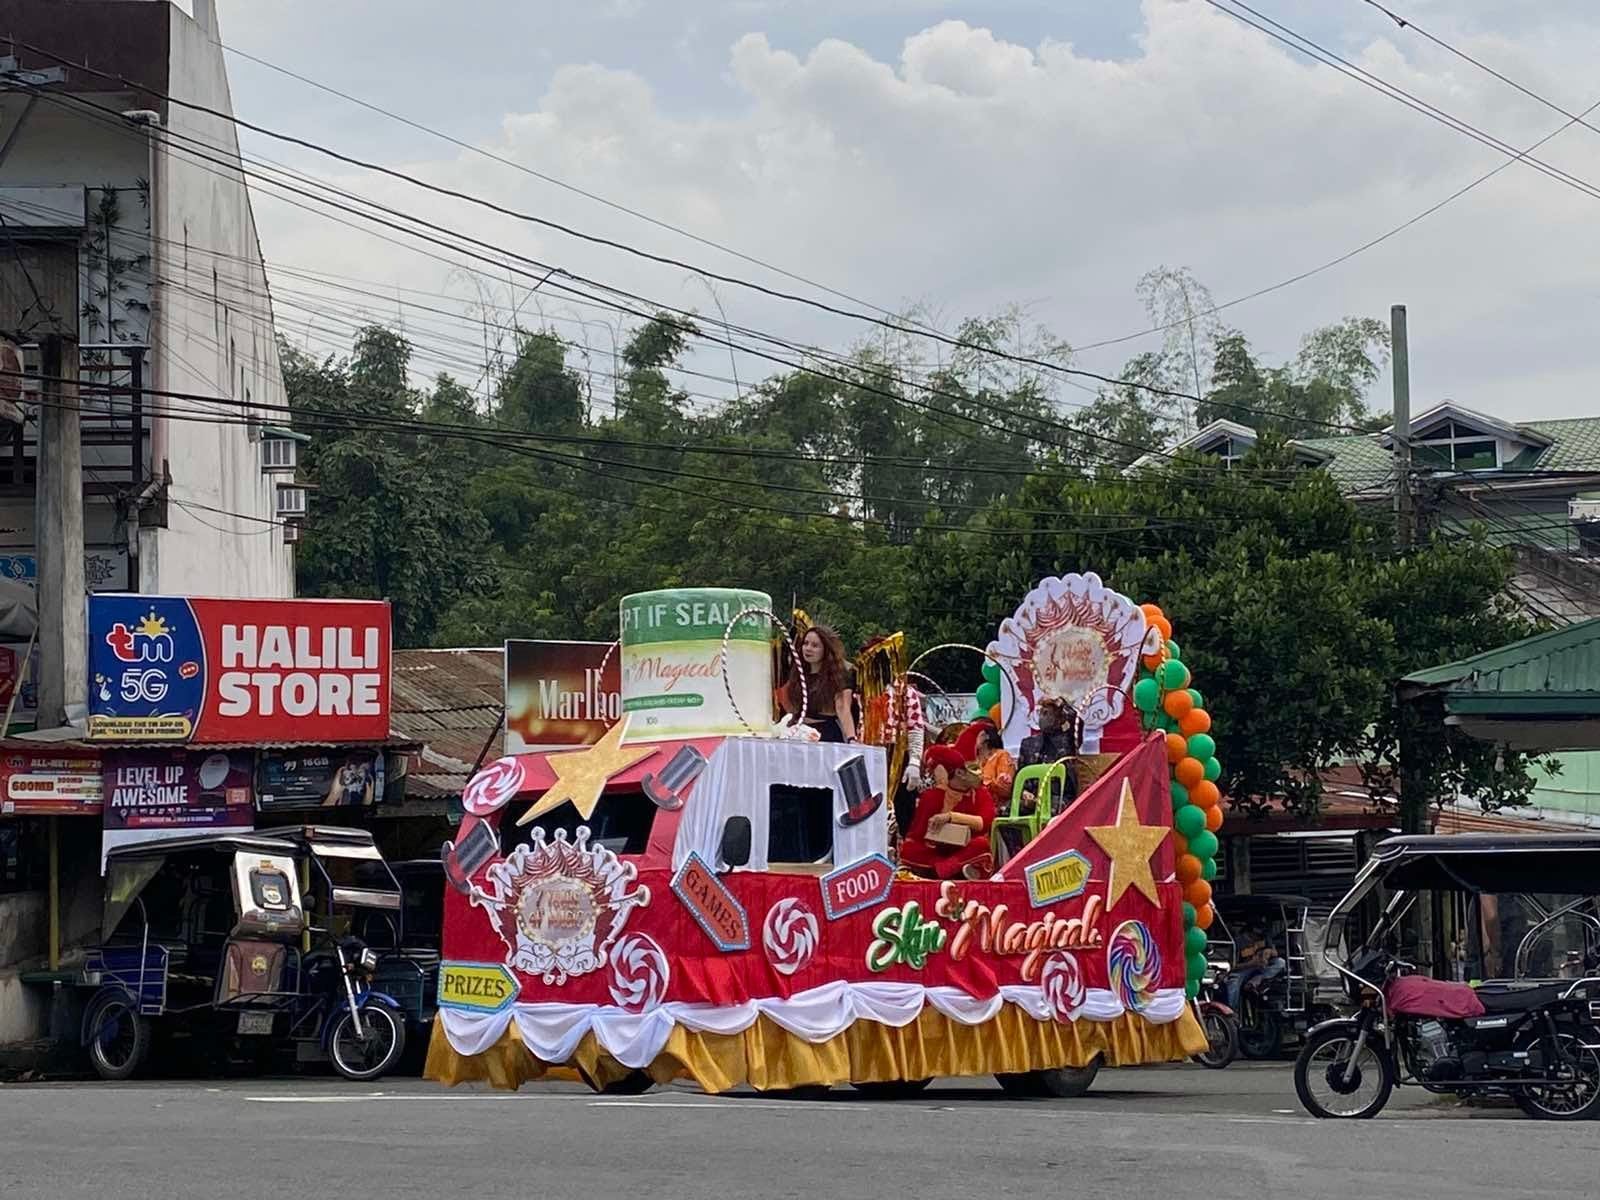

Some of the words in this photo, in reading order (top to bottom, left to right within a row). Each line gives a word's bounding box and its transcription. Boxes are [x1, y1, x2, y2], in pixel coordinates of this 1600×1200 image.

[648, 604, 668, 628] IF
[675, 602, 731, 627] SEAL
[106, 623, 174, 662] tm
[221, 624, 379, 669] HALILI
[120, 668, 169, 702] 5G
[634, 654, 721, 692] Magical
[218, 671, 381, 717] STORE
[117, 767, 161, 786] LEVEL
[165, 766, 184, 784] UP
[111, 786, 189, 807] AWESOME
[835, 869, 880, 903] FOOD
[686, 870, 740, 939] GAMES
[865, 900, 948, 973] Skin
[950, 894, 1102, 982] Magical
[444, 973, 506, 998] PRIZES
